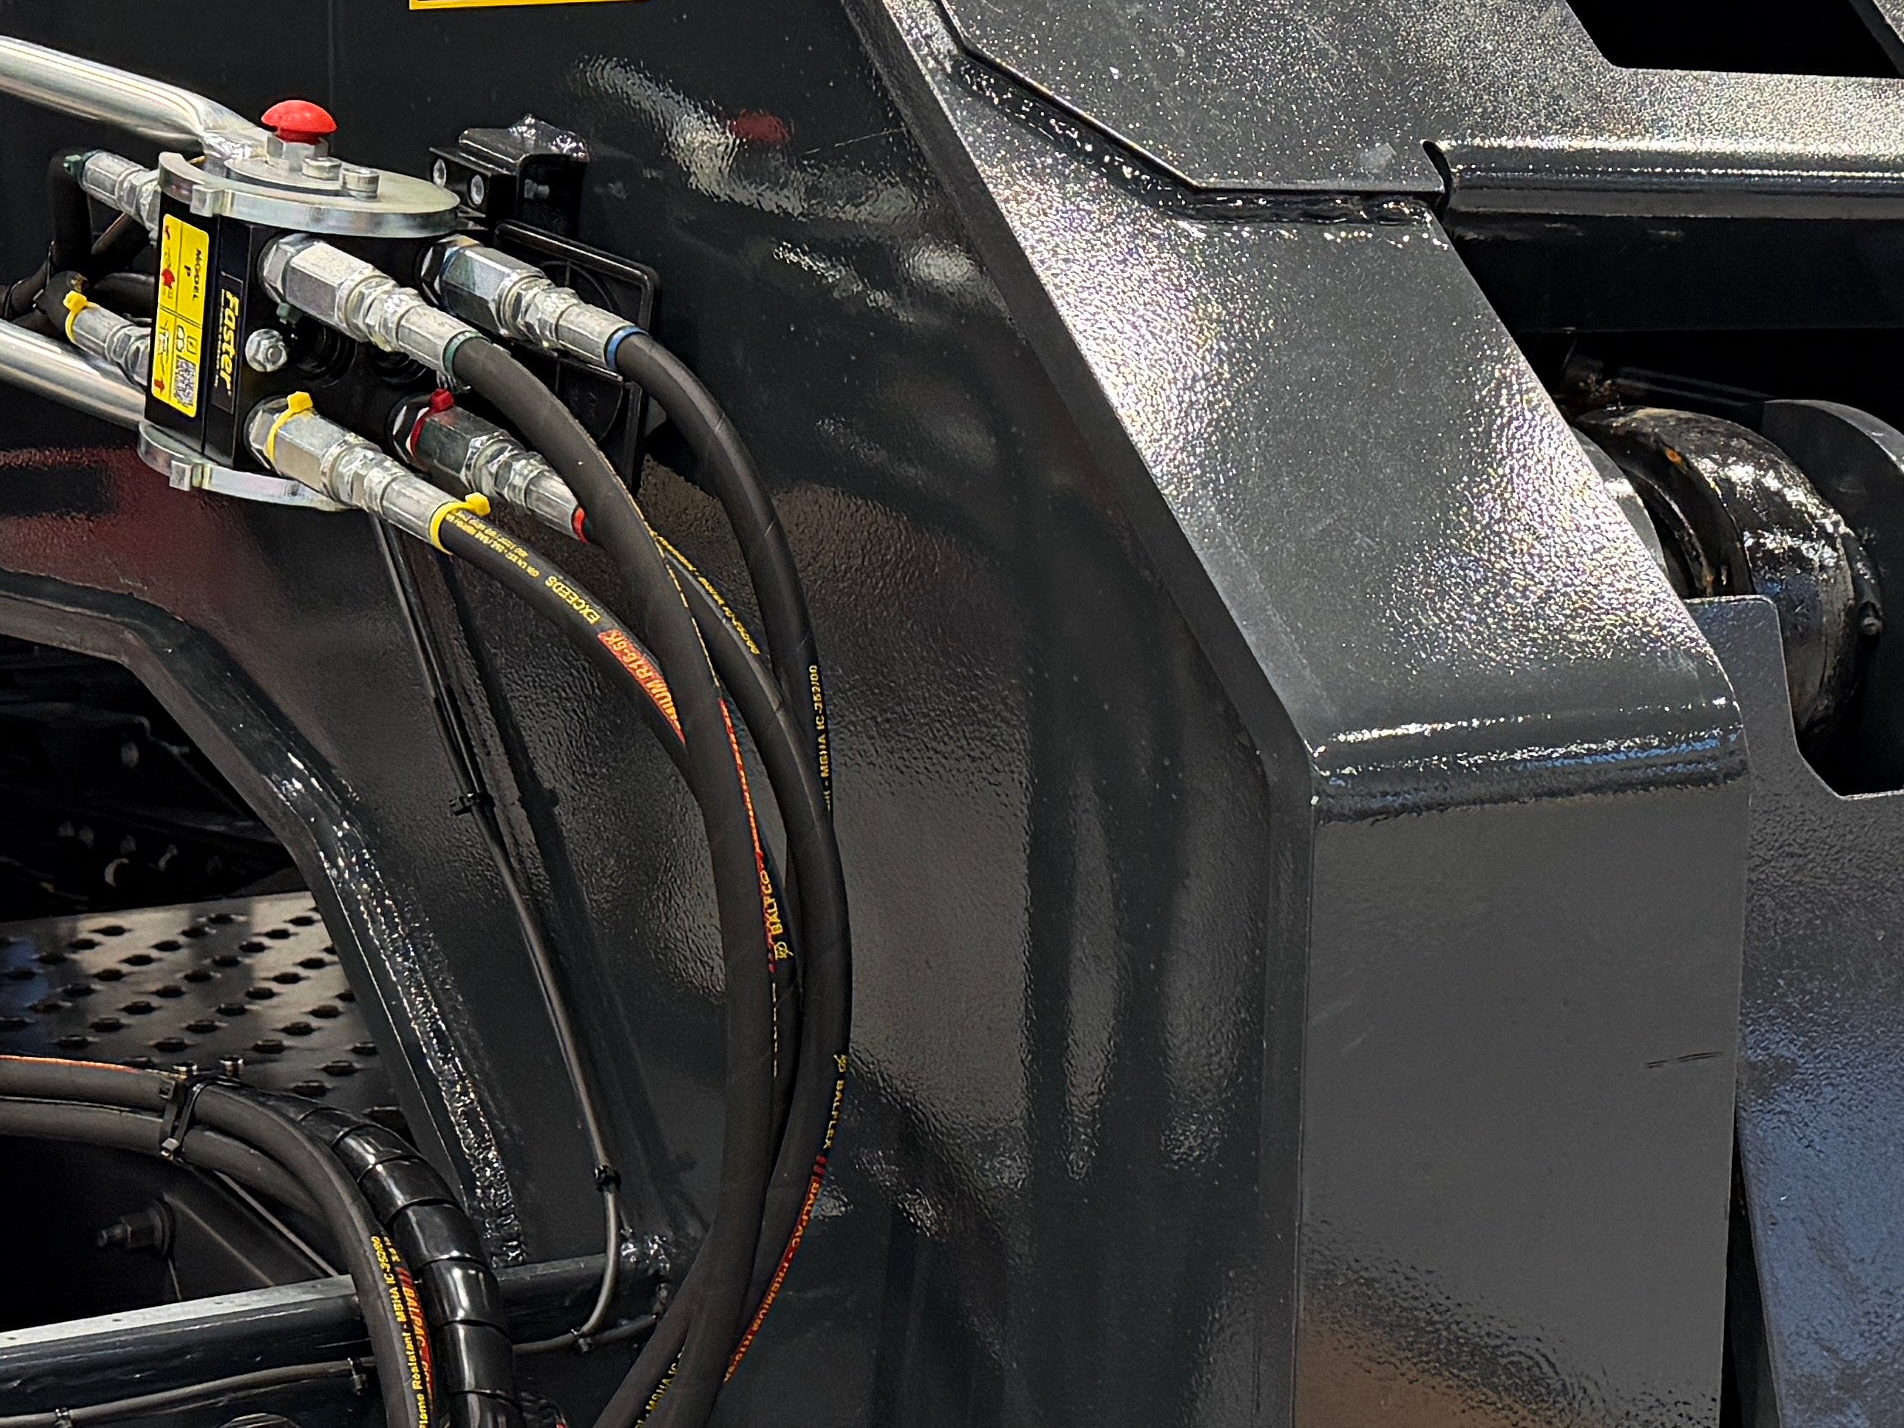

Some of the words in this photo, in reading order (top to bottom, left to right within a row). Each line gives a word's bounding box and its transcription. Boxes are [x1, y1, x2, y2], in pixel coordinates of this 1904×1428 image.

[192, 248, 203, 301] MODEL
[219, 289, 240, 396] Faster
[545, 575, 601, 624] EXCEEDS
